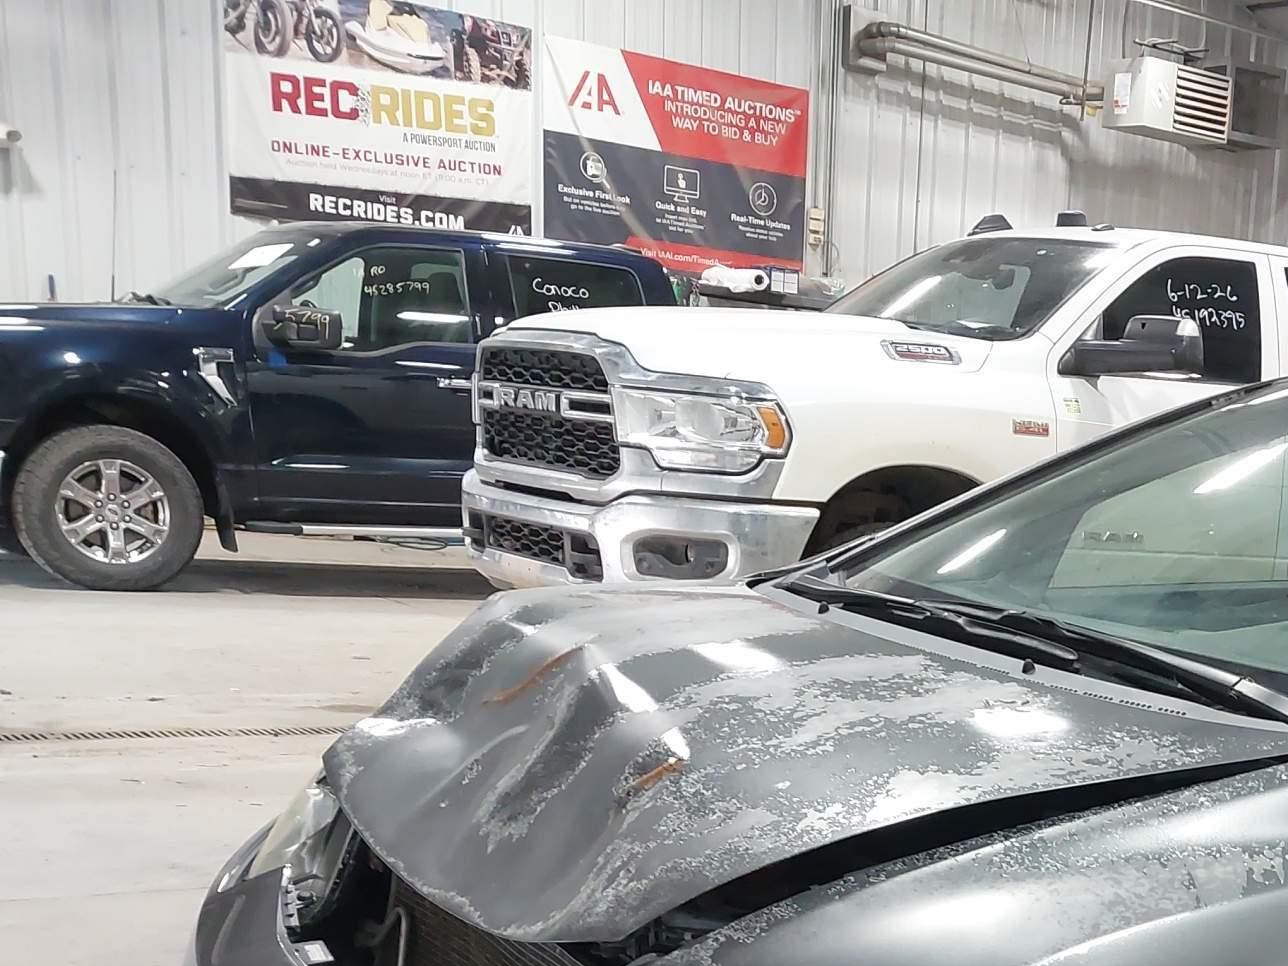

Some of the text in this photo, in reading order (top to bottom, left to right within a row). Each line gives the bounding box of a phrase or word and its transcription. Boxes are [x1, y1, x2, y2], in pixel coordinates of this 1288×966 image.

[270, 72, 496, 137] REC RIDES
[648, 79, 673, 97] IAA
[674, 85, 721, 108] TIMED
[664, 99, 786, 135] INTRODUCING A NEW
[671, 114, 779, 146] WAY TO BID & BUY
[402, 132, 496, 153] A POWERSPORT AUCTION
[271, 139, 502, 177] ONLINE-EXCLUSIVE AUCTION
[378, 194, 396, 204] Visit
[557, 183, 594, 198] Exclusive
[309, 192, 465, 230] RECRIDES.COM
[655, 200, 675, 212] Quick
[676, 206, 690, 214] and
[690, 206, 707, 218] Easy
[731, 213, 765, 226] Real-Time
[765, 218, 791, 231] Updates
[640, 248, 657, 258] Visit
[364, 281, 430, 297] 45285799
[532, 277, 590, 299] Conoco
[1167, 279, 1238, 302] 6-12-26
[500, 387, 556, 413] RAM
